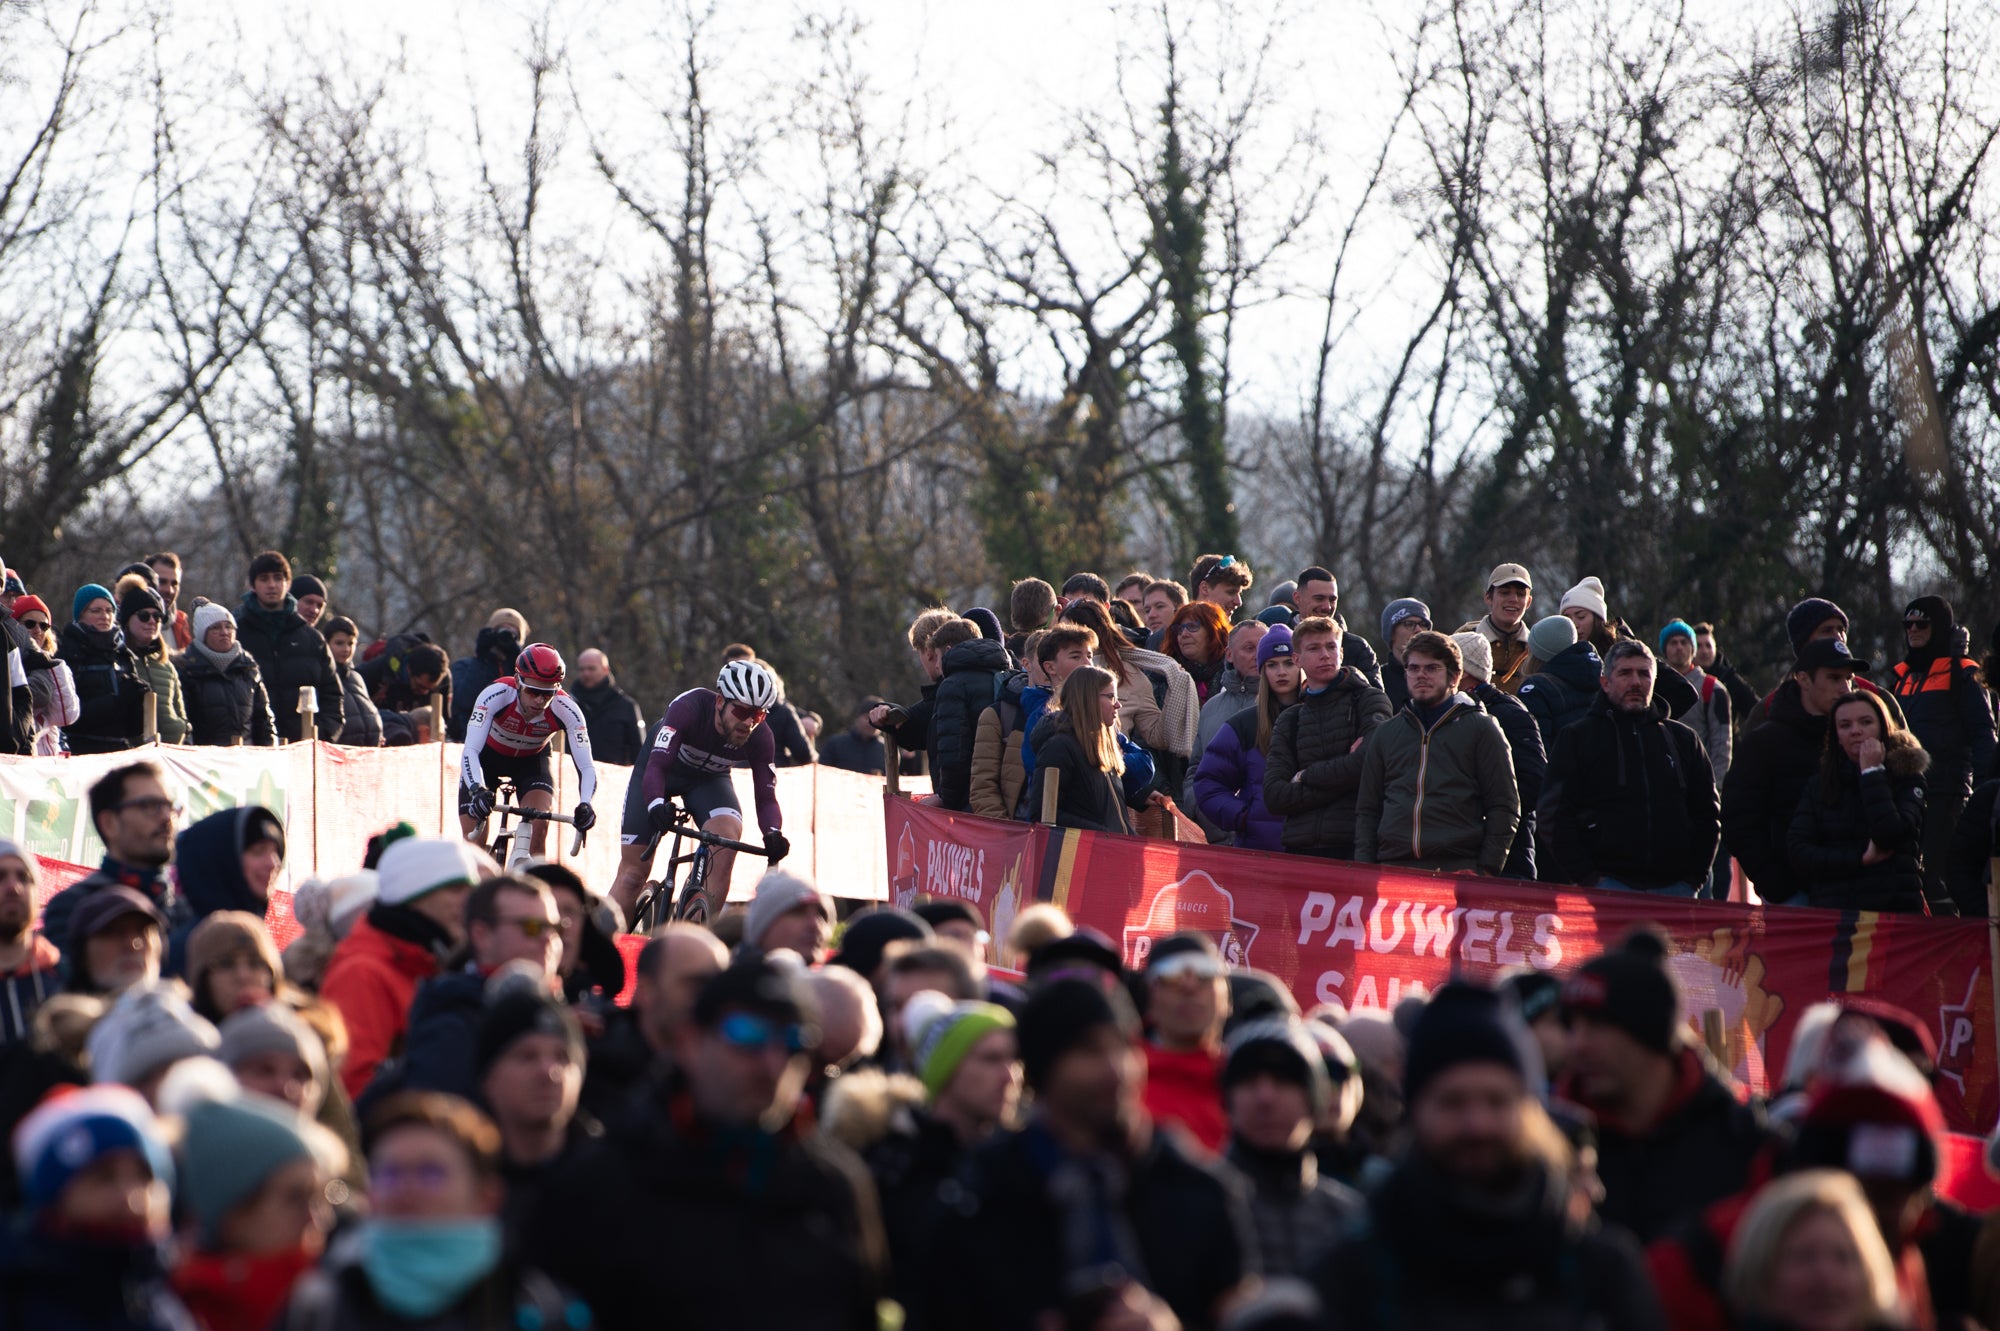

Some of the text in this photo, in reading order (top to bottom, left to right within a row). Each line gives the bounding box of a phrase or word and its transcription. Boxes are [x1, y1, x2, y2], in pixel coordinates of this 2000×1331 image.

[470, 711, 484, 723] 53
[657, 732, 669, 742] 16
[926, 839, 985, 903] PAUWELS
[1176, 901, 1208, 913] SAUCES
[1298, 890, 1563, 970] PAUWELS
